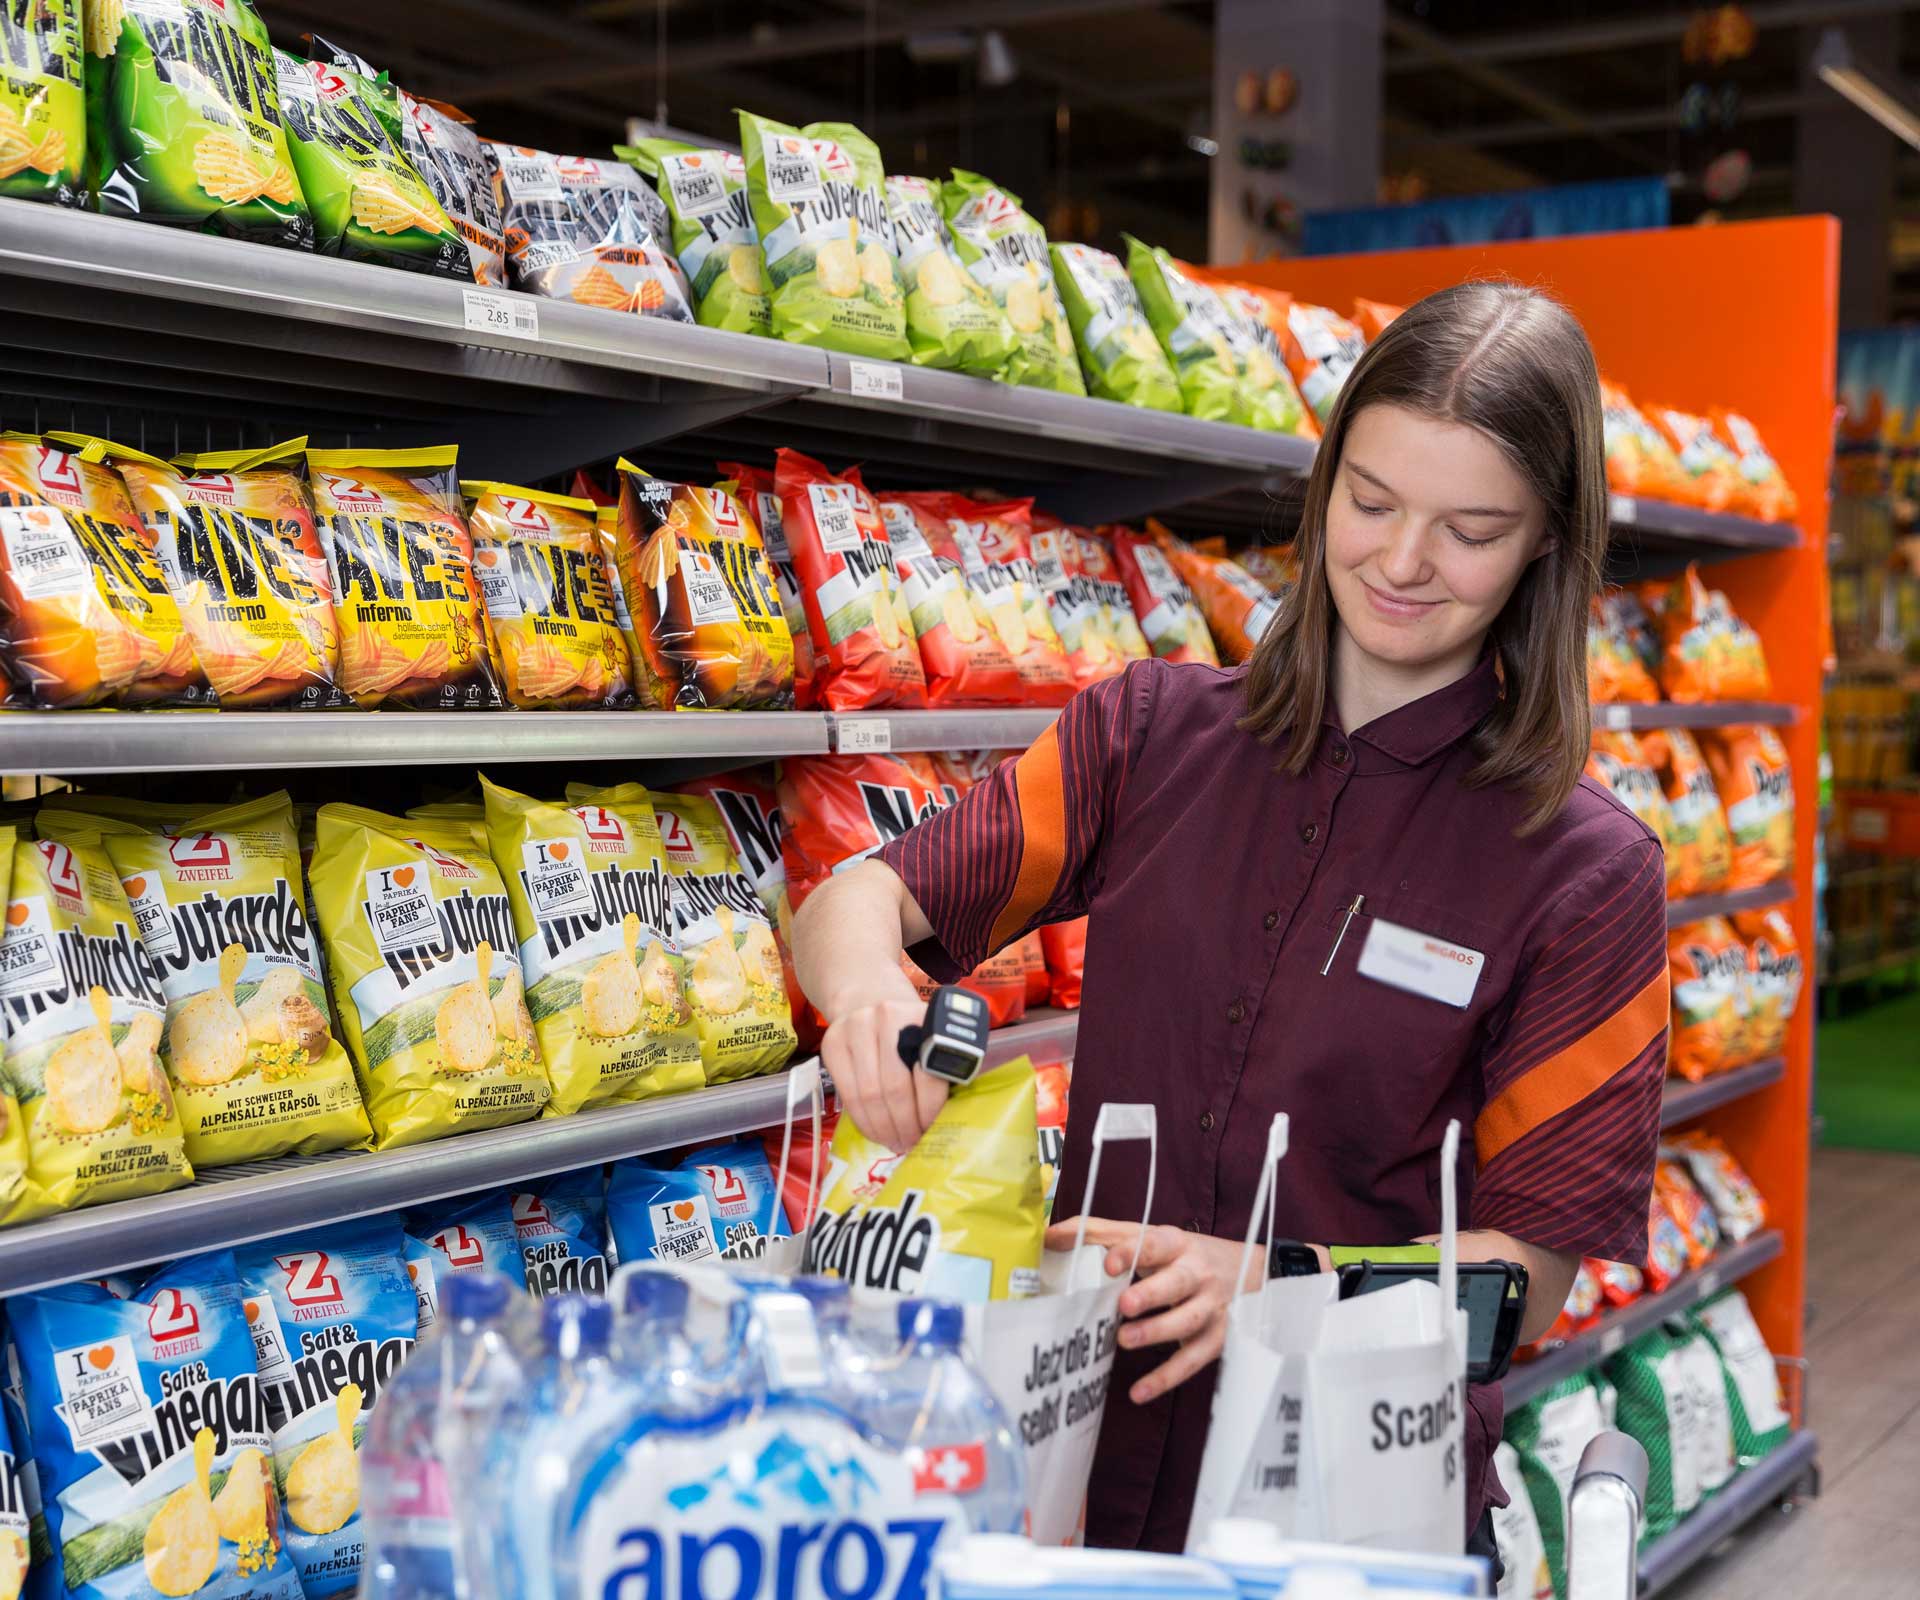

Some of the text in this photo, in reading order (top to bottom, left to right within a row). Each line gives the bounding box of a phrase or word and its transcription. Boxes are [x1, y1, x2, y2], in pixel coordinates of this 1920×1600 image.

[239, 117, 274, 144] ream
[509, 167, 547, 178] PAPRIKA
[772, 165, 810, 179] PAPRIKA
[781, 174, 804, 185] FANS
[677, 177, 714, 195] PAPRIKA
[688, 188, 710, 200] FANS
[487, 309, 509, 324] 2.85
[43, 488, 86, 508] ZWEIFEL
[186, 489, 236, 506] ZWEIFEL
[336, 501, 386, 513] ZWEIFEL
[17, 546, 68, 568] PAPRIKA
[429, 521, 470, 603] CHIPS
[587, 551, 618, 628] CHIPS
[692, 585, 723, 598] PAPRIKA
[703, 593, 722, 605] FANS
[205, 603, 267, 622] inferno
[356, 604, 413, 622] inferno
[533, 618, 578, 637] inferno
[536, 844, 549, 864] I
[588, 841, 628, 854] ZWEIFEL
[176, 867, 234, 882] ZWEIFEL
[380, 870, 393, 892] I
[440, 866, 479, 879] ZWEIFEL
[535, 871, 580, 893] PAPRIKA
[547, 883, 575, 899] FANS
[378, 898, 426, 923] PAPRIKA
[392, 911, 420, 929] FANS
[149, 879, 311, 983] outarde
[1, 953, 36, 973] FANS
[265, 954, 311, 973] ORIGINAL CHIPS
[717, 1033, 756, 1050] ALPENSALZ
[762, 1026, 789, 1041] RAPSÖL
[734, 1022, 775, 1035] MIT SCHWEIZER
[620, 1050, 632, 1060] MIT
[600, 1055, 644, 1075] ALPENSALZ
[454, 1089, 536, 1109] ALPENSALZ & RAPSÖL
[480, 1083, 522, 1096] MIT SCHWEIZER
[227, 1089, 294, 1111] MIT SCHWEIZER
[200, 1092, 321, 1129] ALPENSALZ & RAPSÖL
[290, 1112, 304, 1122] ALPES
[100, 1144, 153, 1161] MIT SCHWEIZER
[76, 1160, 127, 1180] ALPENSALZ
[137, 1151, 169, 1169] RAPSÖL
[662, 1206, 672, 1225] I
[720, 1203, 750, 1218] ZWEIFEL
[663, 1231, 705, 1253] PAPRIKA
[675, 1243, 700, 1258] FANS
[292, 1304, 350, 1323] ZWEIFEL
[153, 1336, 203, 1361] ZWEIFEL
[72, 1351, 88, 1377] I
[72, 1381, 129, 1414] PAPRIKA
[90, 1399, 122, 1419] FANS
[230, 1437, 258, 1447] ORIGINAL
[334, 1546, 348, 1560] MIT
[601, 1518, 946, 1600] aproz
[304, 1555, 364, 1576] ALPENSAL
